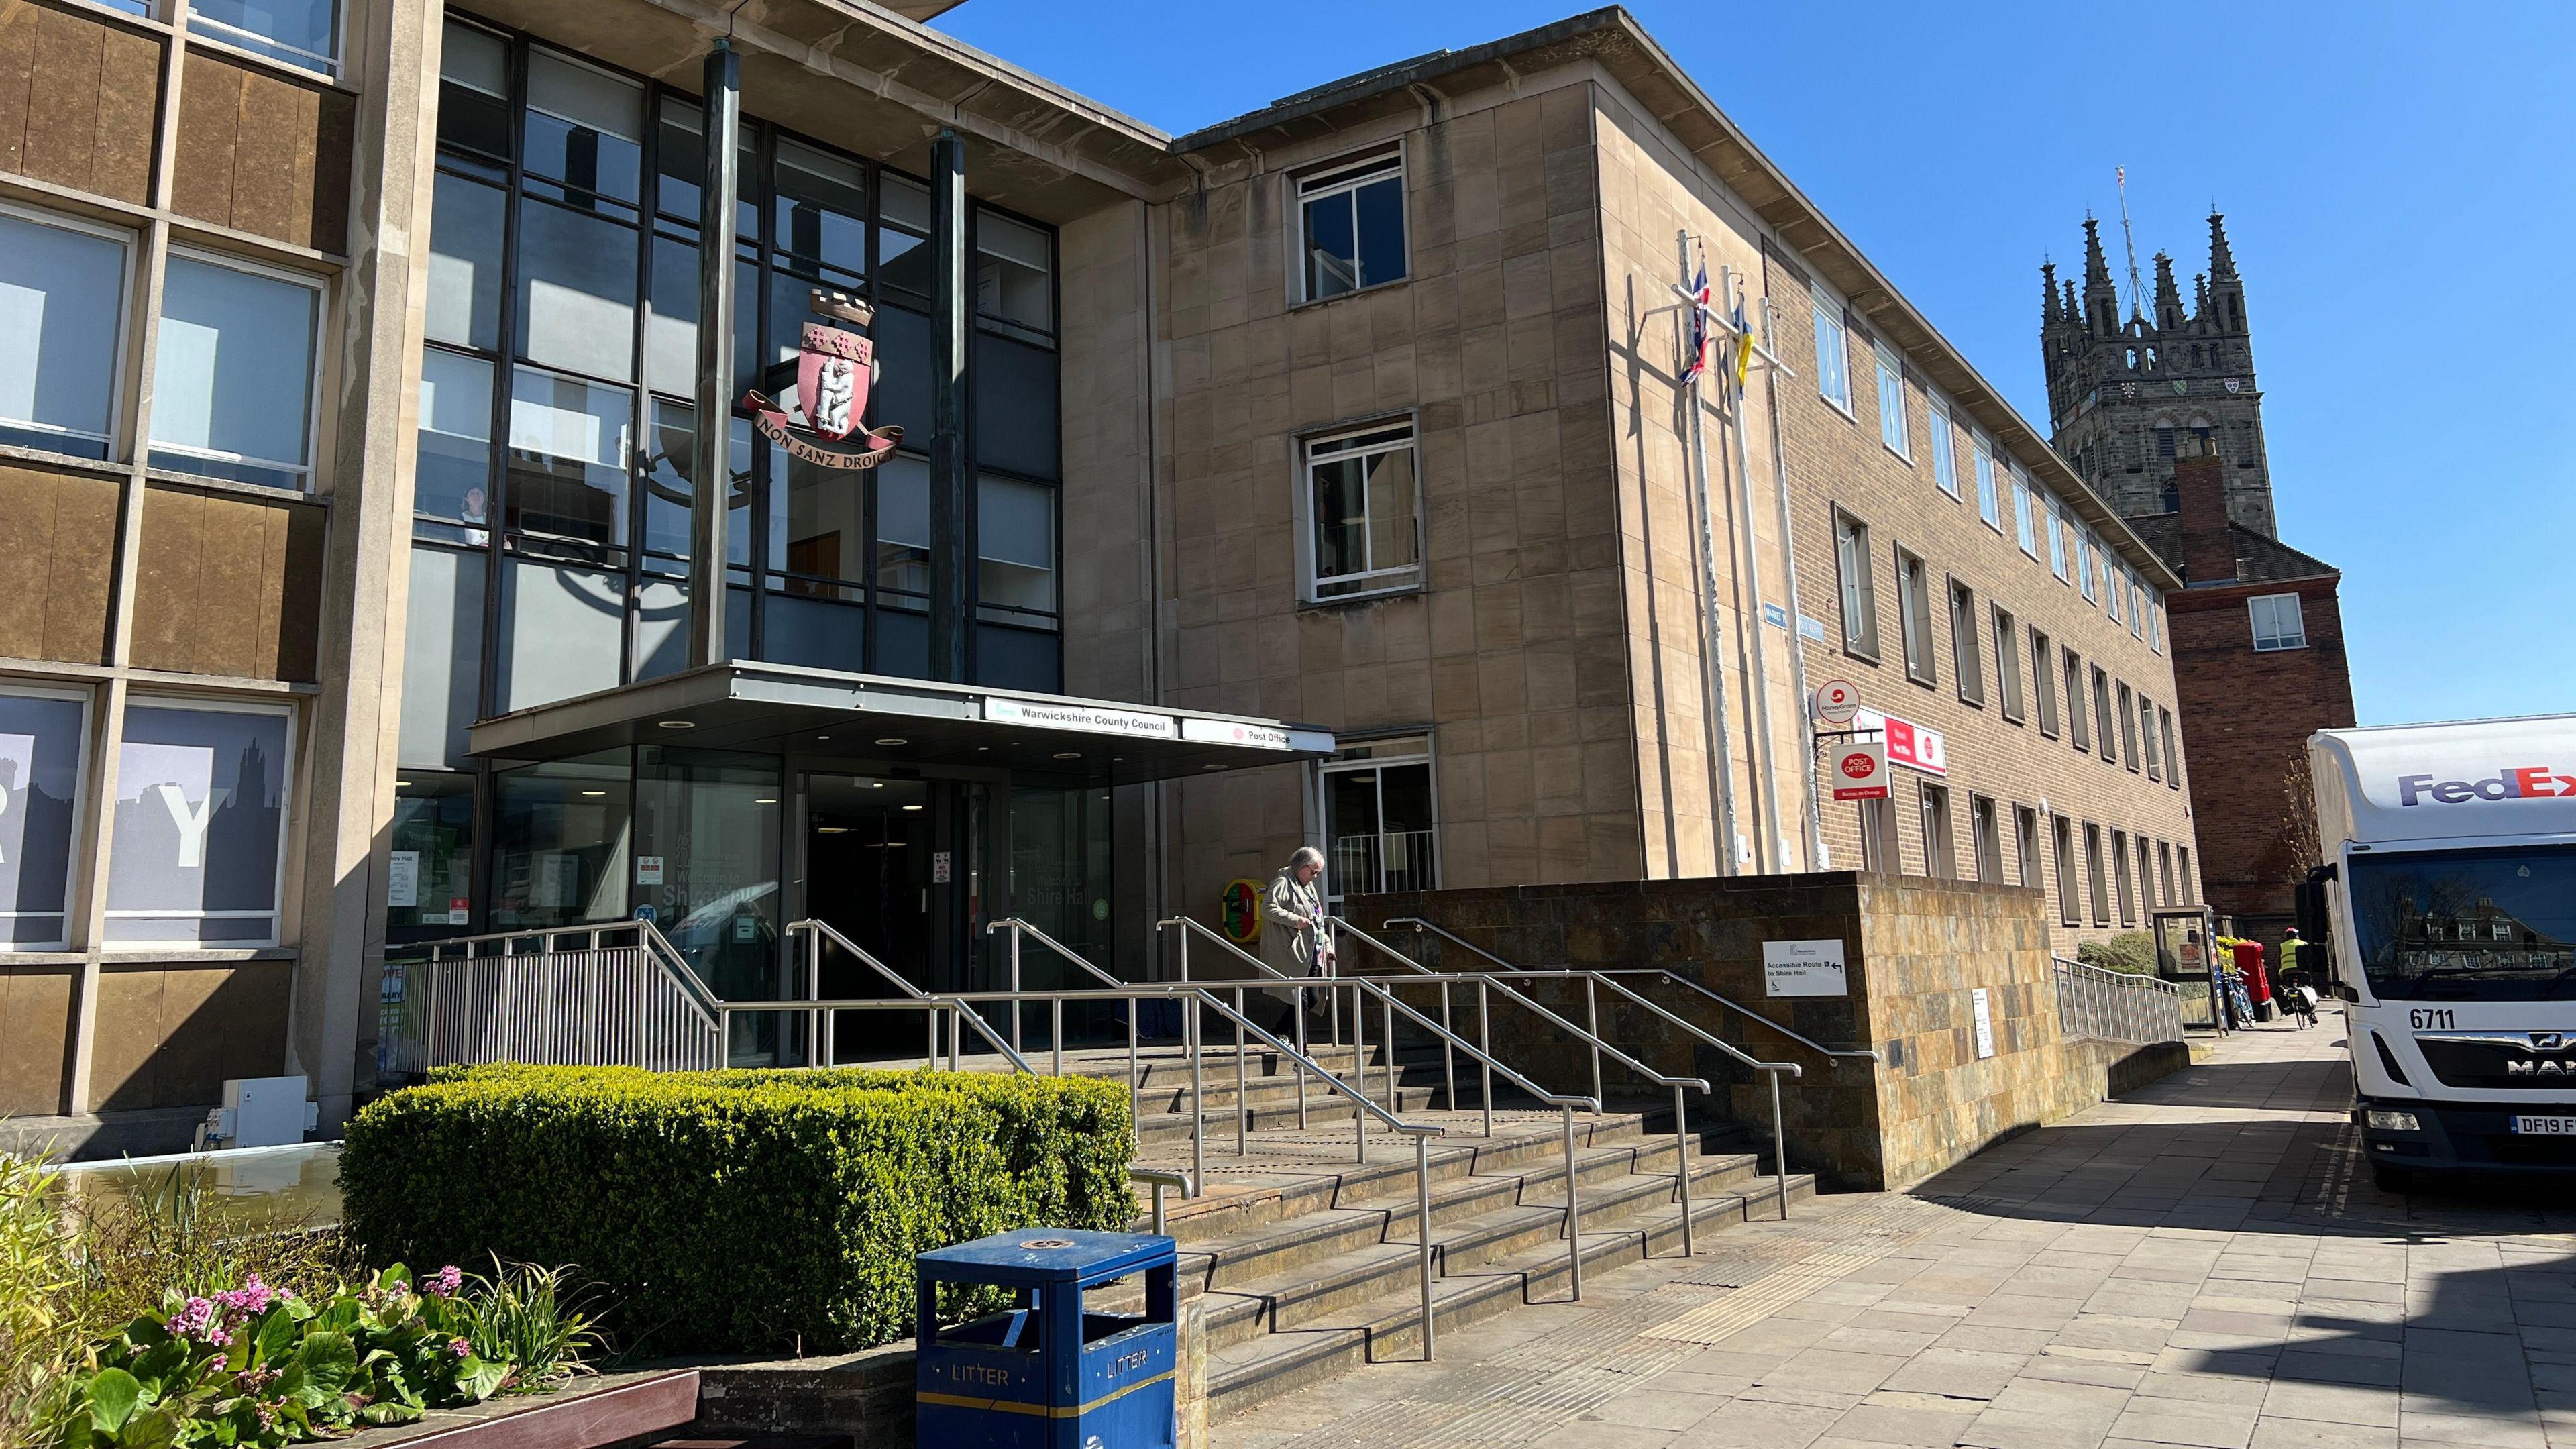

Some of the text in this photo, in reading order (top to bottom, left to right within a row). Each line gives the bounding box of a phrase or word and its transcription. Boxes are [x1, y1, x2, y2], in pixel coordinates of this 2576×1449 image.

[759, 418, 894, 468] NON SANZ DROICT
[1022, 708, 1165, 731] Warwickshire County Council
[1248, 731, 1291, 744] Post Office
[1845, 765, 1872, 773] OFFICE
[676, 870, 741, 883] Welcome to
[1027, 886, 1091, 905] Shire Hall
[2410, 1008, 2455, 1030] 6711
[2522, 1118, 2576, 1133] DF19 F
[1107, 1349, 1148, 1379] LITTER
[951, 1364, 1009, 1386] LITTER
